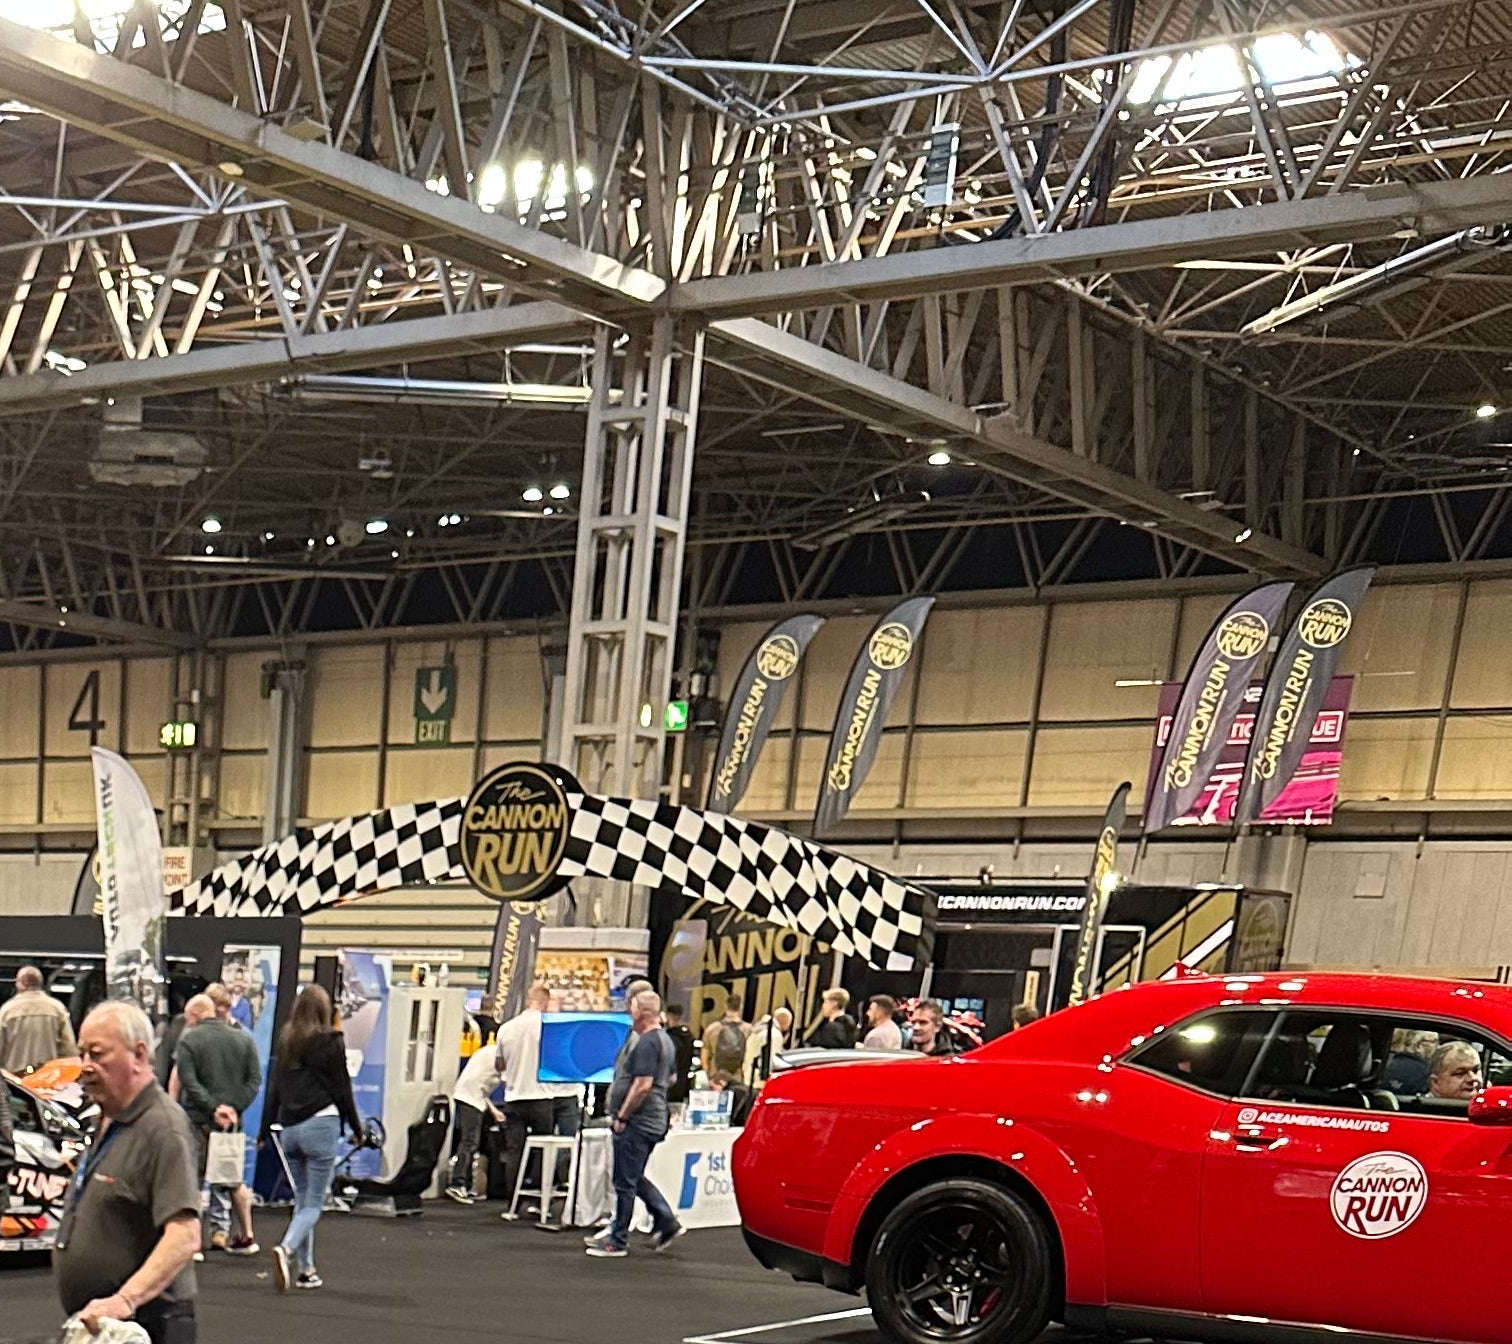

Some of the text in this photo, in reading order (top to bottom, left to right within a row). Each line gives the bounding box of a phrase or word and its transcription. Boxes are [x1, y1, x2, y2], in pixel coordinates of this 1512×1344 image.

[1220, 632, 1260, 656] RUN
[1302, 620, 1343, 645] RUN
[68, 670, 106, 746] 4
[743, 678, 768, 719] RUN
[1260, 687, 1299, 779] CANNON
[1290, 649, 1314, 690] RUN
[420, 720, 446, 741] EXIT
[838, 708, 867, 791] CANNON
[856, 669, 882, 711] RUN
[1174, 698, 1215, 788] CANNON
[1204, 660, 1230, 700] RUN
[495, 781, 546, 802] The
[467, 803, 564, 830] CANNON
[470, 832, 555, 893] RUN
[1257, 1111, 1390, 1133] ACEAMERICANAUTOS
[1338, 1177, 1425, 1193] CANNON
[1343, 1196, 1413, 1234] RUN
